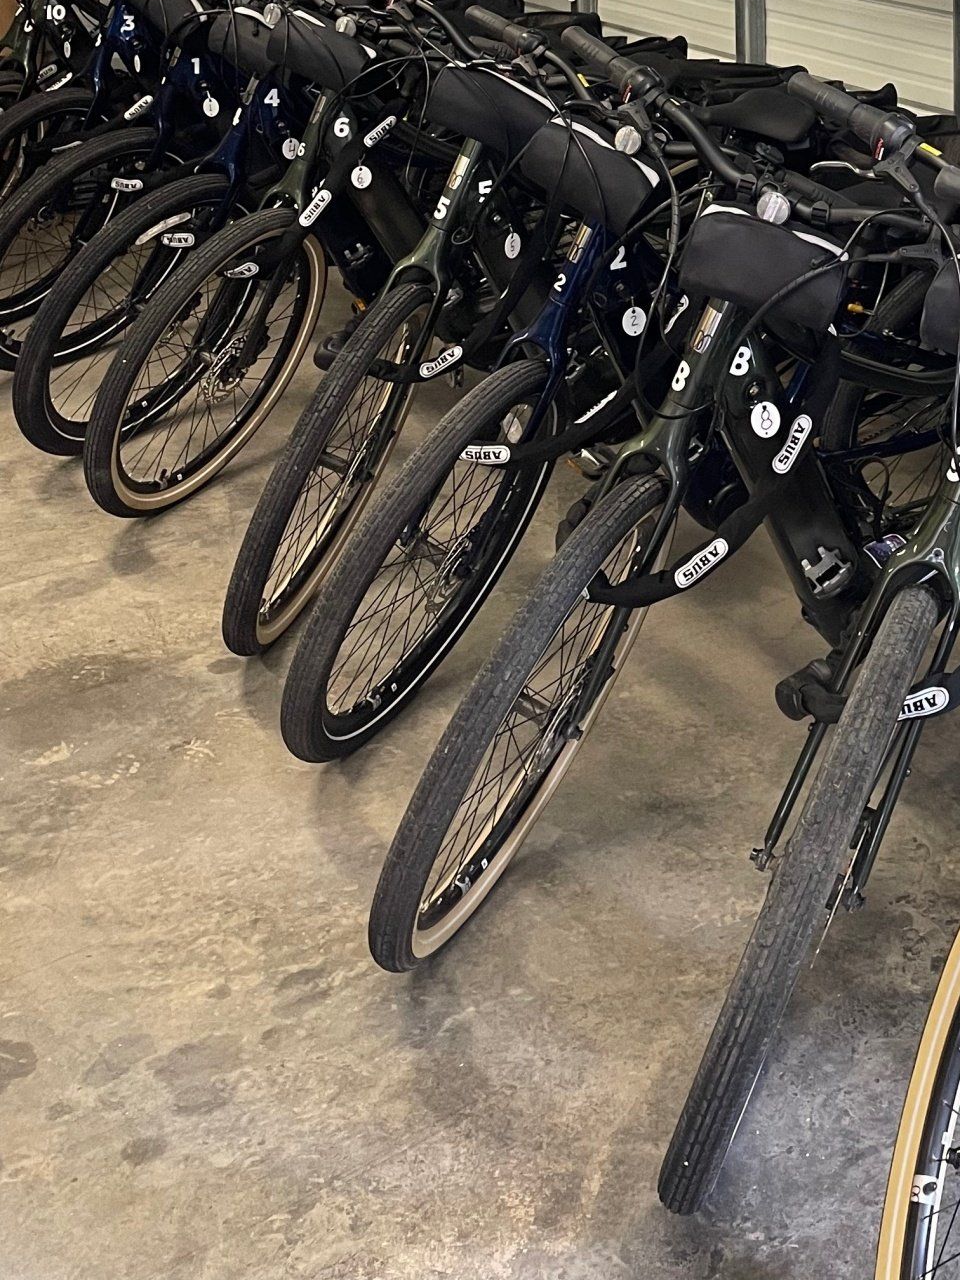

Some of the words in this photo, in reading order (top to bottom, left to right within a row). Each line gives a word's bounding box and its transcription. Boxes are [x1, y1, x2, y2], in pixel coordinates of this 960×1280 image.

[44, 4, 66, 20] 10
[120, 15, 136, 33] 3
[191, 58, 200, 74] 1
[264, 88, 280, 107] 4
[334, 117, 350, 138] 6
[369, 120, 394, 144] ABUS
[297, 142, 306, 156] 6
[356, 172, 364, 184] 6
[303, 194, 326, 222] ABUS
[434, 196, 450, 220] 5
[610, 245, 628, 270] 2
[553, 274, 567, 292] 2
[630, 315, 639, 327] 2
[426, 349, 456, 374] ABUS
[760, 409, 773, 431] 8
[777, 422, 807, 466] ABUS
[465, 450, 504, 461] ABUS
[682, 545, 720, 582] ABUS
